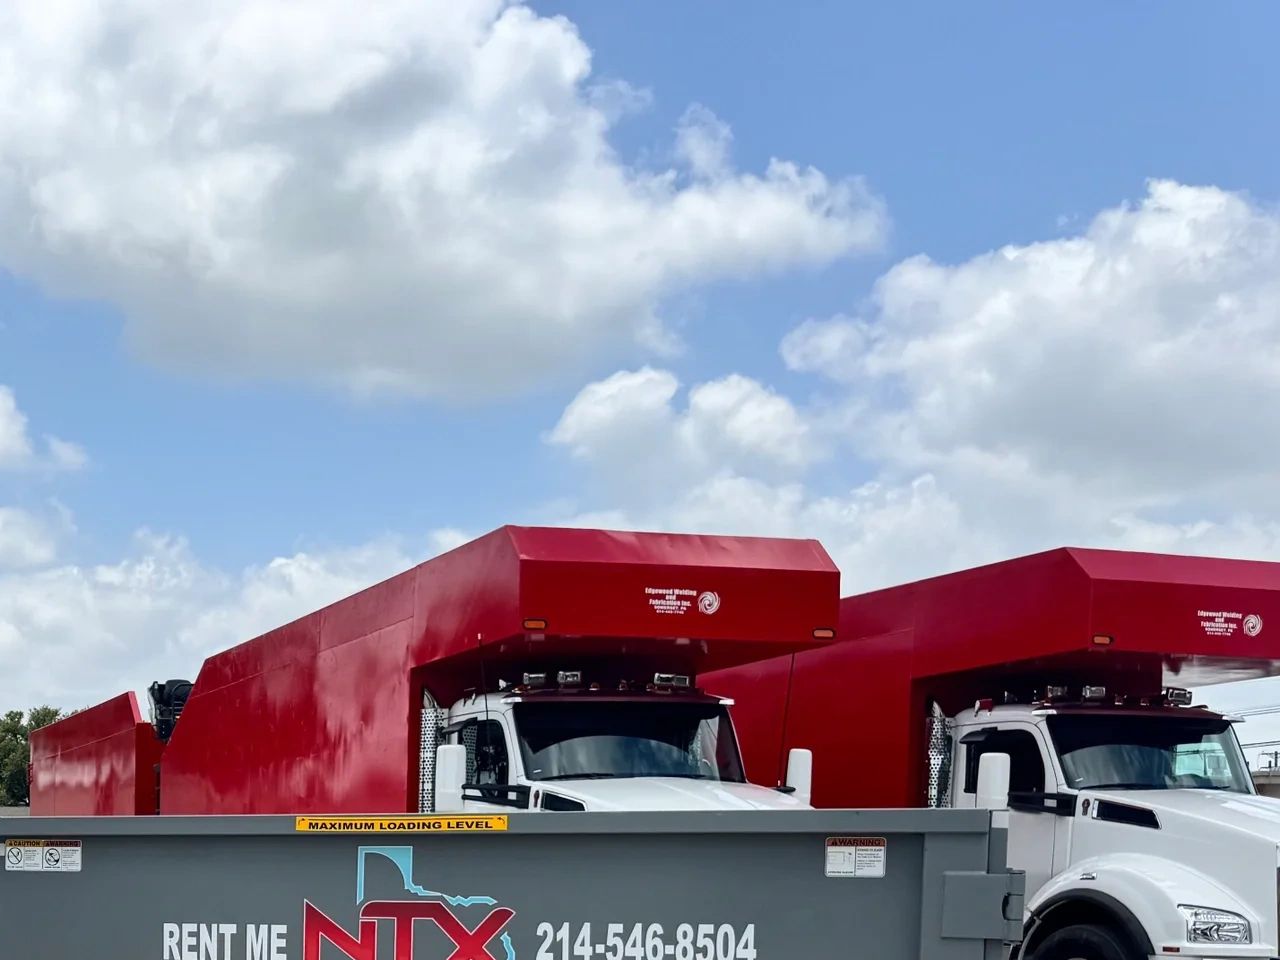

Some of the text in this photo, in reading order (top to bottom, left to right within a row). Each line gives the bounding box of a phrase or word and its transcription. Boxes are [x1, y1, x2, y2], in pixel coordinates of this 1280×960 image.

[308, 820, 493, 830] MAXIMUM LOADING LEVEL
